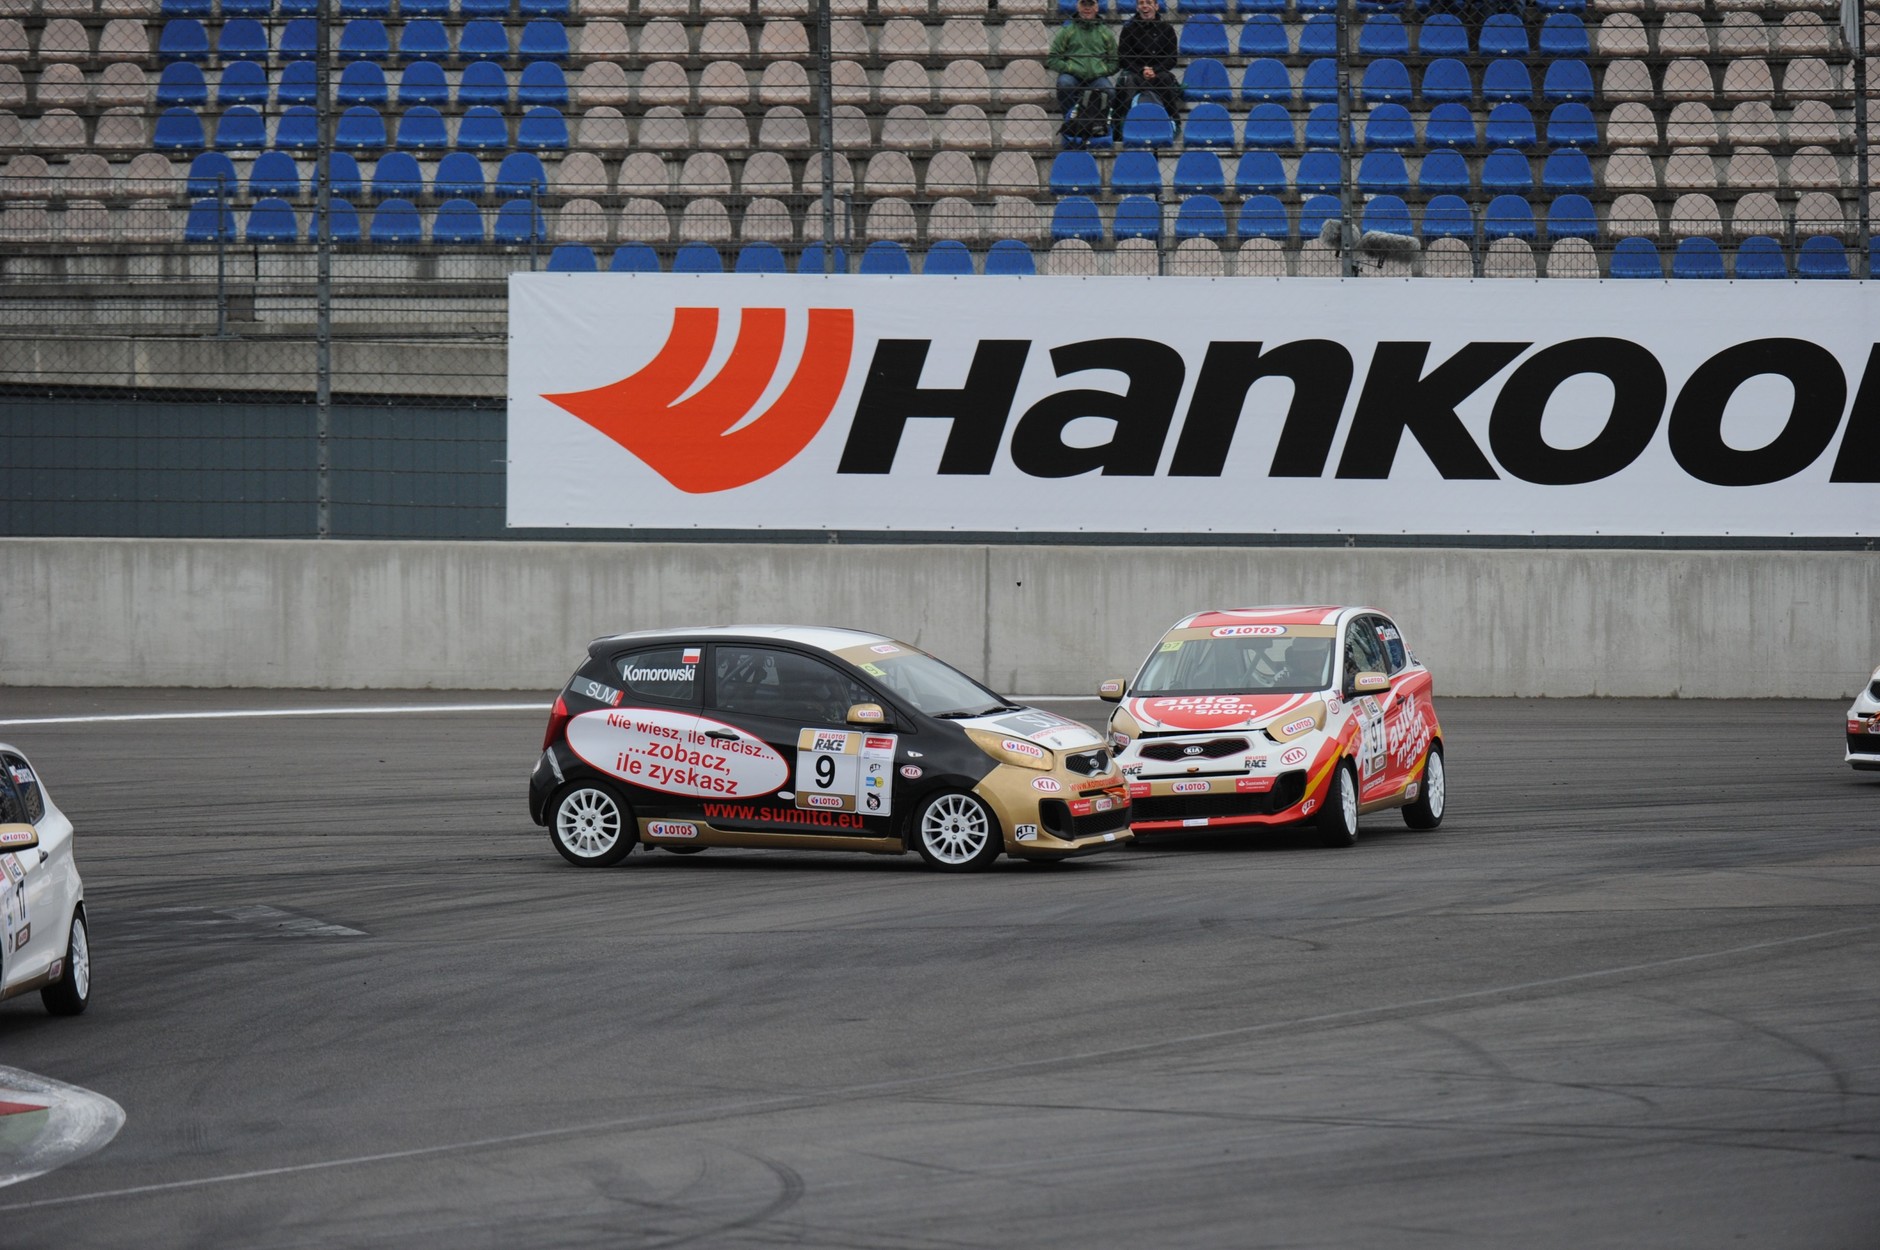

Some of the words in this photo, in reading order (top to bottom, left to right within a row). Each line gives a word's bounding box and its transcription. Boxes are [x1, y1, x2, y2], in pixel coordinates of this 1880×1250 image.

[1163, 642, 1180, 650] 97
[622, 665, 696, 681] Komorowski
[586, 681, 618, 705] SUM
[1154, 696, 1241, 707] auto
[1167, 703, 1253, 711] motor
[1293, 719, 1312, 731] LOTOS
[1390, 692, 1415, 756] auto
[607, 713, 631, 730] Nie
[636, 721, 683, 743] wiesz,
[688, 730, 706, 745] ile
[710, 738, 775, 761] tracisz...
[1370, 717, 1383, 755] 97
[1396, 710, 1423, 768] motor
[814, 738, 844, 752] RACE
[1016, 743, 1040, 756] LOTOS
[628, 741, 731, 775] ...zobacz,
[1284, 749, 1304, 763] KIA
[1244, 760, 1267, 768] RACE
[616, 752, 642, 775] ile
[648, 763, 739, 795] zyskasz
[815, 754, 836, 789] 9
[904, 768, 919, 776] KIA
[1037, 780, 1057, 790] KIA
[1184, 782, 1206, 791] LOTOS
[819, 797, 840, 806] LOTOS
[664, 824, 693, 836] LOTOS
[1016, 825, 1036, 837] ATT
[10, 833, 29, 841] LOTOS
